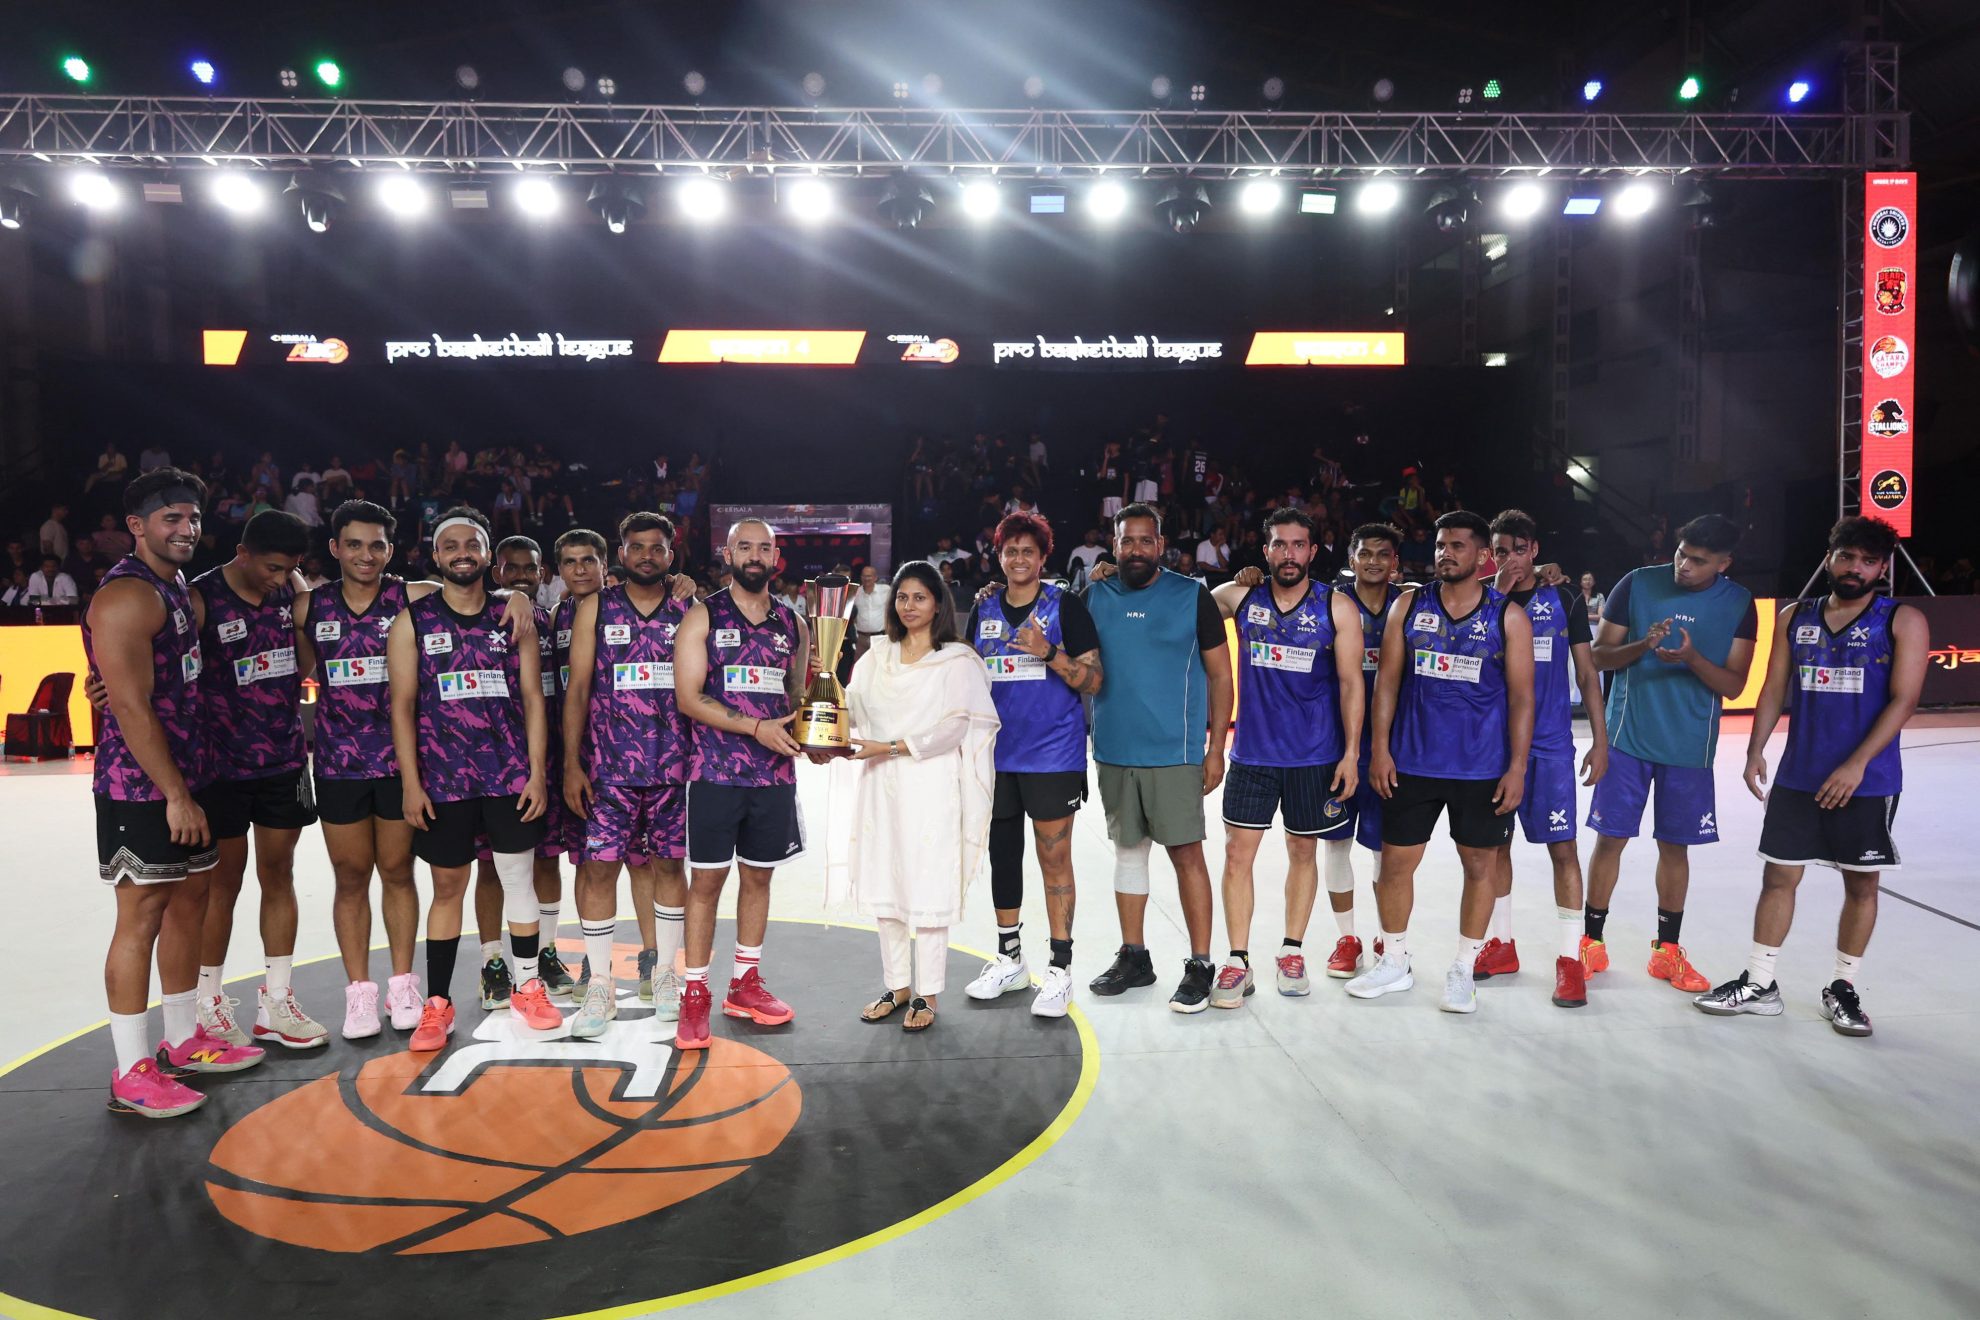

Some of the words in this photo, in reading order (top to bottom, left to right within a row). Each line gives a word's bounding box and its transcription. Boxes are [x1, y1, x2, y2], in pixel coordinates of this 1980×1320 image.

[385, 341, 431, 363] pro
[432, 333, 554, 361] basketball
[556, 333, 634, 362] league
[993, 342, 1035, 364] pro
[1036, 334, 1149, 361] basketball
[1151, 335, 1223, 364] league
[1869, 422, 1908, 432] STALLIONS
[1126, 611, 1146, 619] HRX
[1297, 626, 1317, 634] HRX
[1468, 634, 1487, 642] HRX
[489, 646, 509, 654] HRX
[1286, 647, 1314, 658] Finland
[1416, 651, 1450, 672] FIS
[1453, 656, 1480, 666] Finland
[327, 659, 365, 679] FIS
[616, 664, 650, 682] FIS
[478, 672, 506, 680] Finland
[727, 667, 760, 684] FIS
[440, 672, 478, 692] FIS
[1549, 824, 1569, 832] HRX
